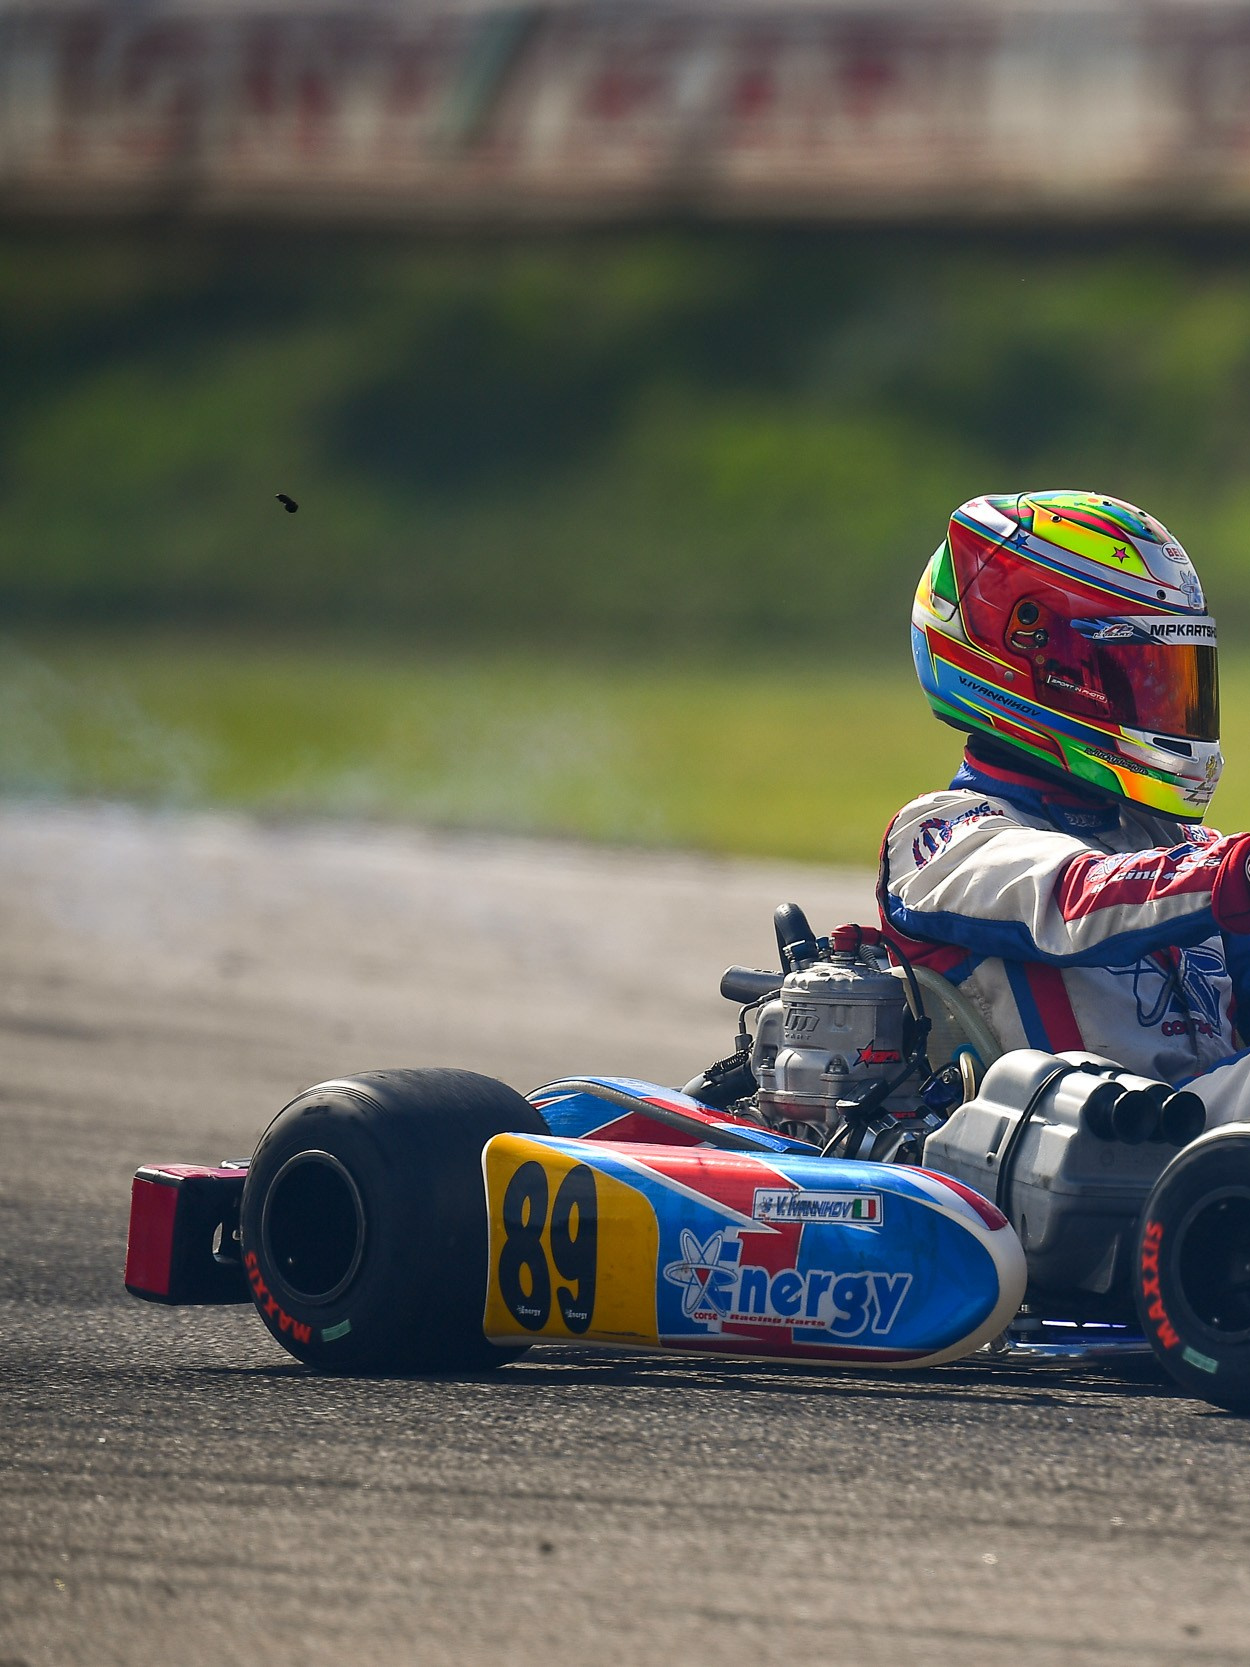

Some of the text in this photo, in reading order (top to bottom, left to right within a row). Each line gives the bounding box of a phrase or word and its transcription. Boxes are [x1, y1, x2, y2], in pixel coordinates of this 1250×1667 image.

[498, 1160, 598, 1335] 89
[699, 1241, 909, 1335] Energy
[1141, 1221, 1180, 1350] MAXXIS
[243, 1251, 313, 1344] MAXXIS
[694, 1312, 718, 1321] corse
[730, 1314, 826, 1327] Racing Karts
